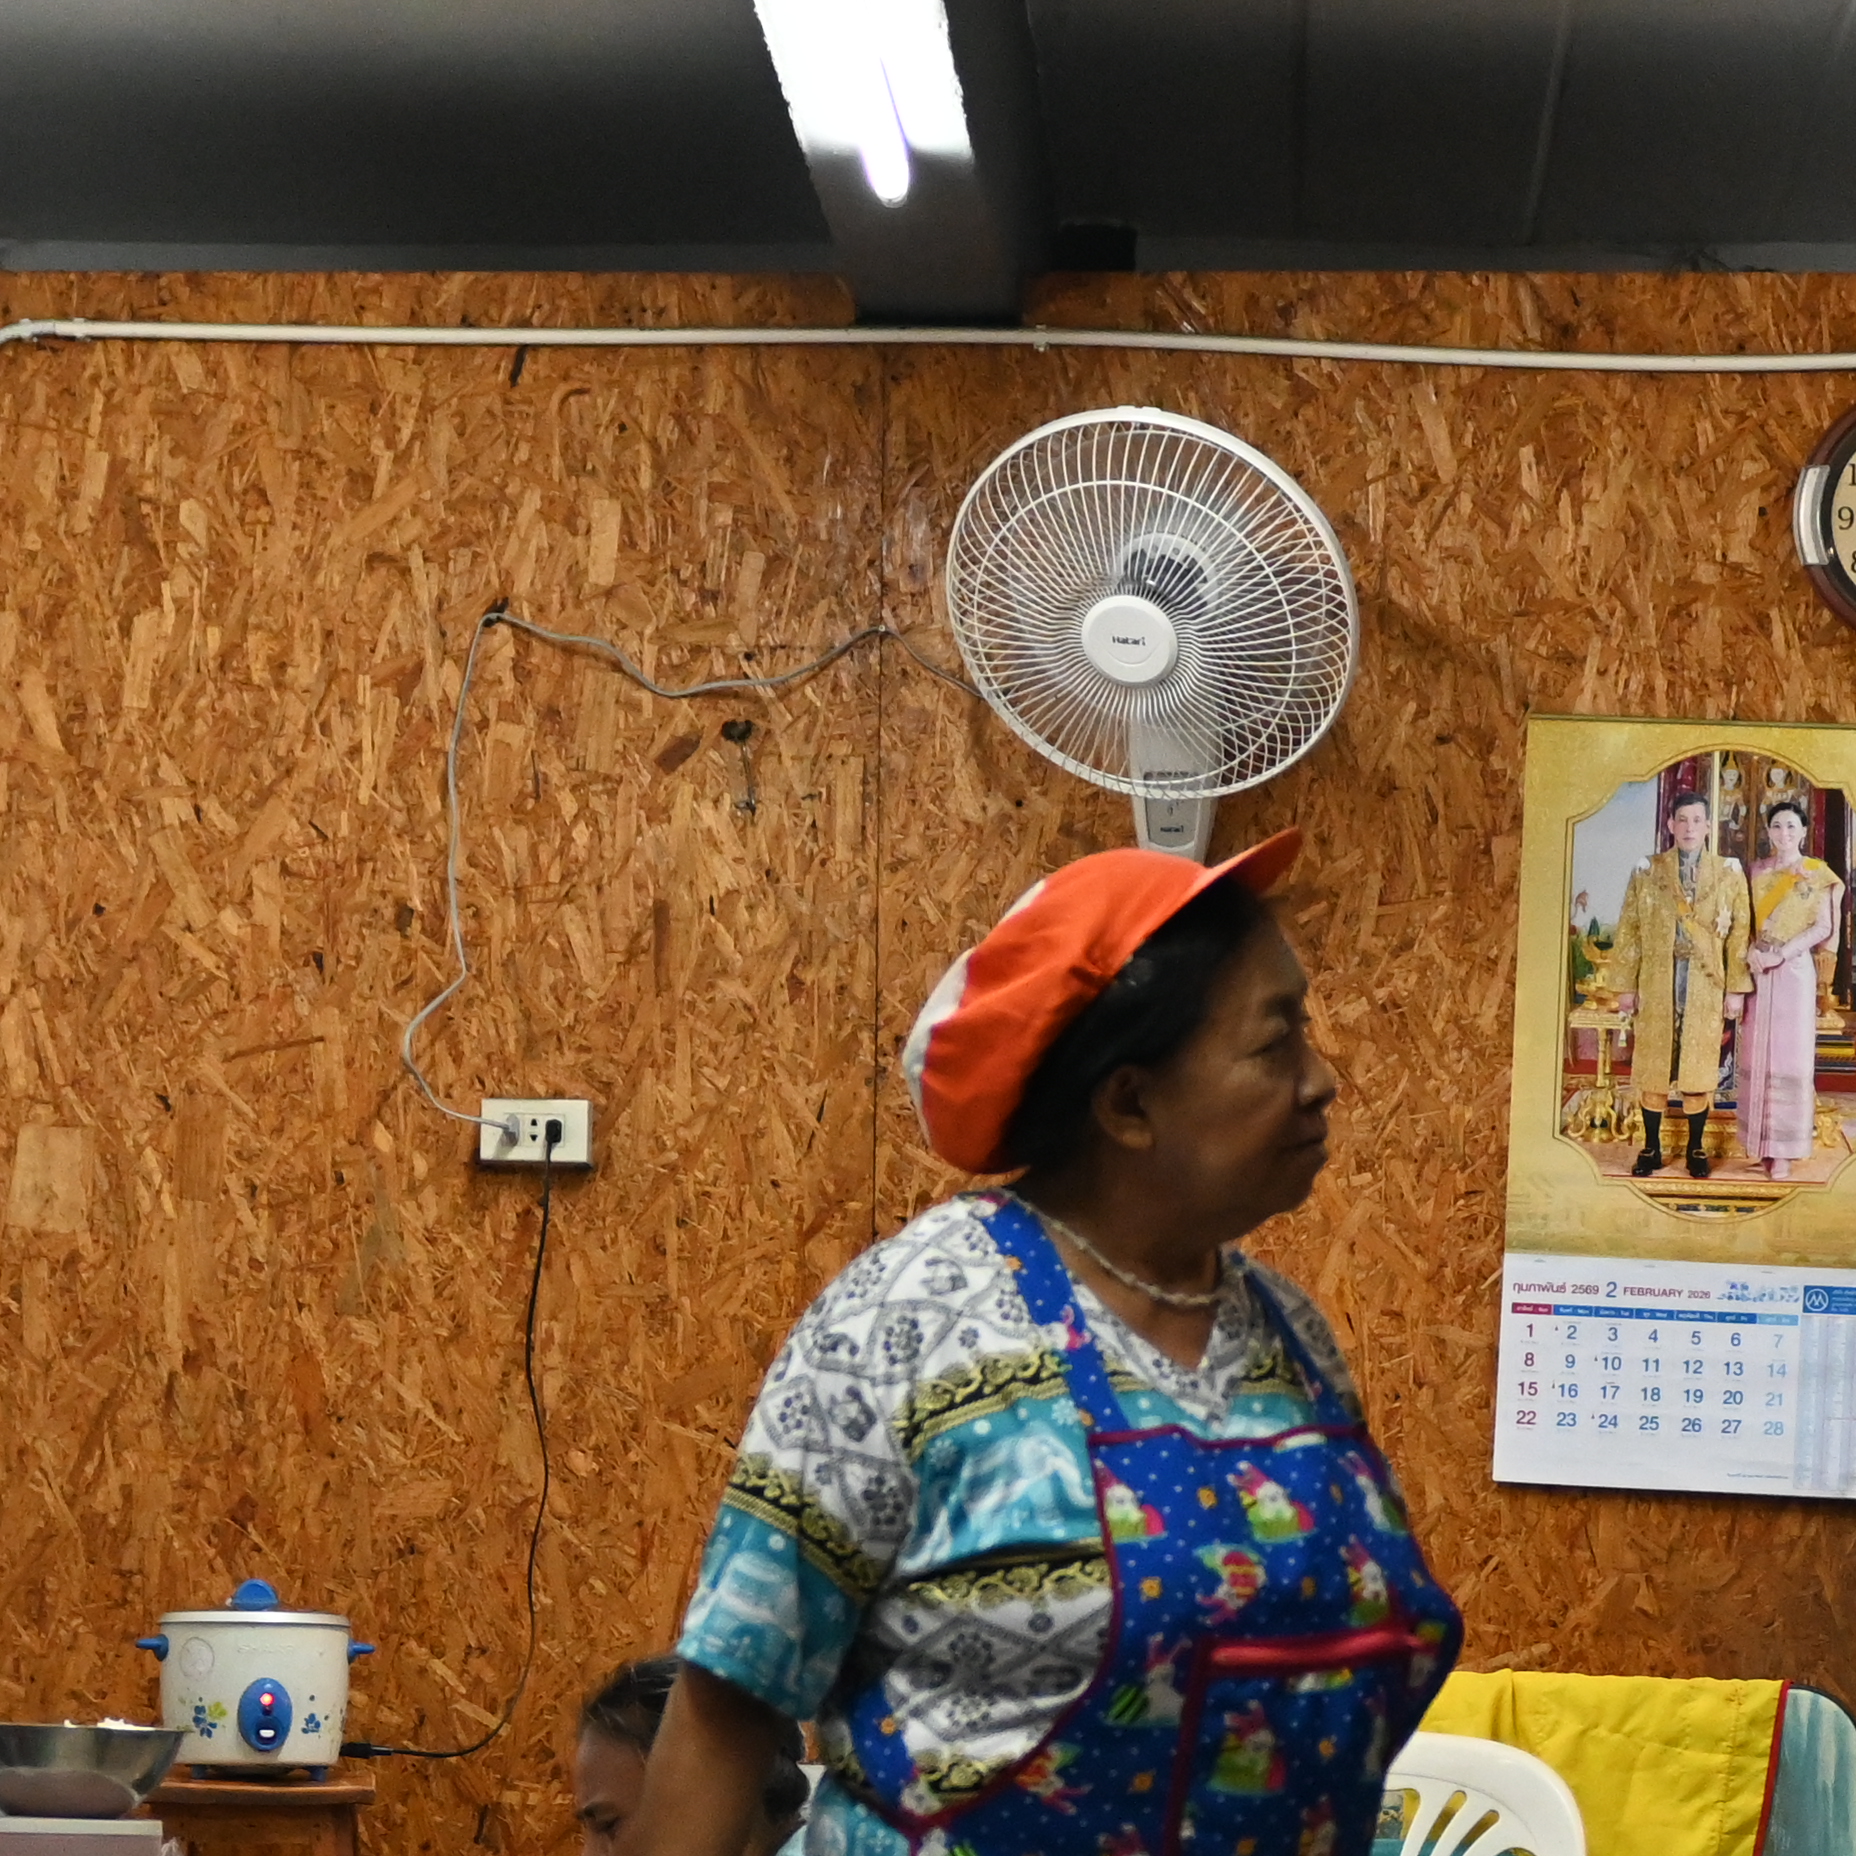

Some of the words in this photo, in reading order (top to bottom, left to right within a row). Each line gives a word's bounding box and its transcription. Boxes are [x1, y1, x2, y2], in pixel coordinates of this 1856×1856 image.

[1838, 507, 1854, 530] 9
[1572, 1284, 1599, 1294] 2569
[1606, 1282, 1617, 1298] 2
[1624, 1287, 1683, 1297] FEBRUARY
[1527, 1324, 1533, 1337] 1
[1567, 1325, 1577, 1339] 2
[1608, 1327, 1617, 1341] 3
[1649, 1329, 1658, 1342] 4
[1692, 1331, 1701, 1345] 5
[1731, 1333, 1740, 1346] 6
[1774, 1334, 1783, 1348] 7
[1525, 1353, 1534, 1366] 8
[1566, 1354, 1575, 1368] 9
[1602, 1357, 1621, 1370] 10
[1643, 1358, 1659, 1372] 11
[1683, 1360, 1703, 1374] 12
[1724, 1362, 1743, 1376] 13
[1768, 1364, 1786, 1377] 14
[1518, 1382, 1537, 1396] 15
[1559, 1384, 1578, 1398] 16
[1601, 1386, 1619, 1399] 17
[1642, 1387, 1660, 1401] 18
[1684, 1389, 1703, 1403] 19
[1723, 1390, 1743, 1405] 20
[1766, 1392, 1782, 1406] 21
[1516, 1410, 1536, 1425] 22
[1557, 1412, 1576, 1426] 23
[1599, 1414, 1617, 1428] 24
[1639, 1416, 1659, 1430] 25
[1682, 1418, 1701, 1432] 26
[1721, 1420, 1741, 1433] 27
[1764, 1422, 1783, 1435] 28
